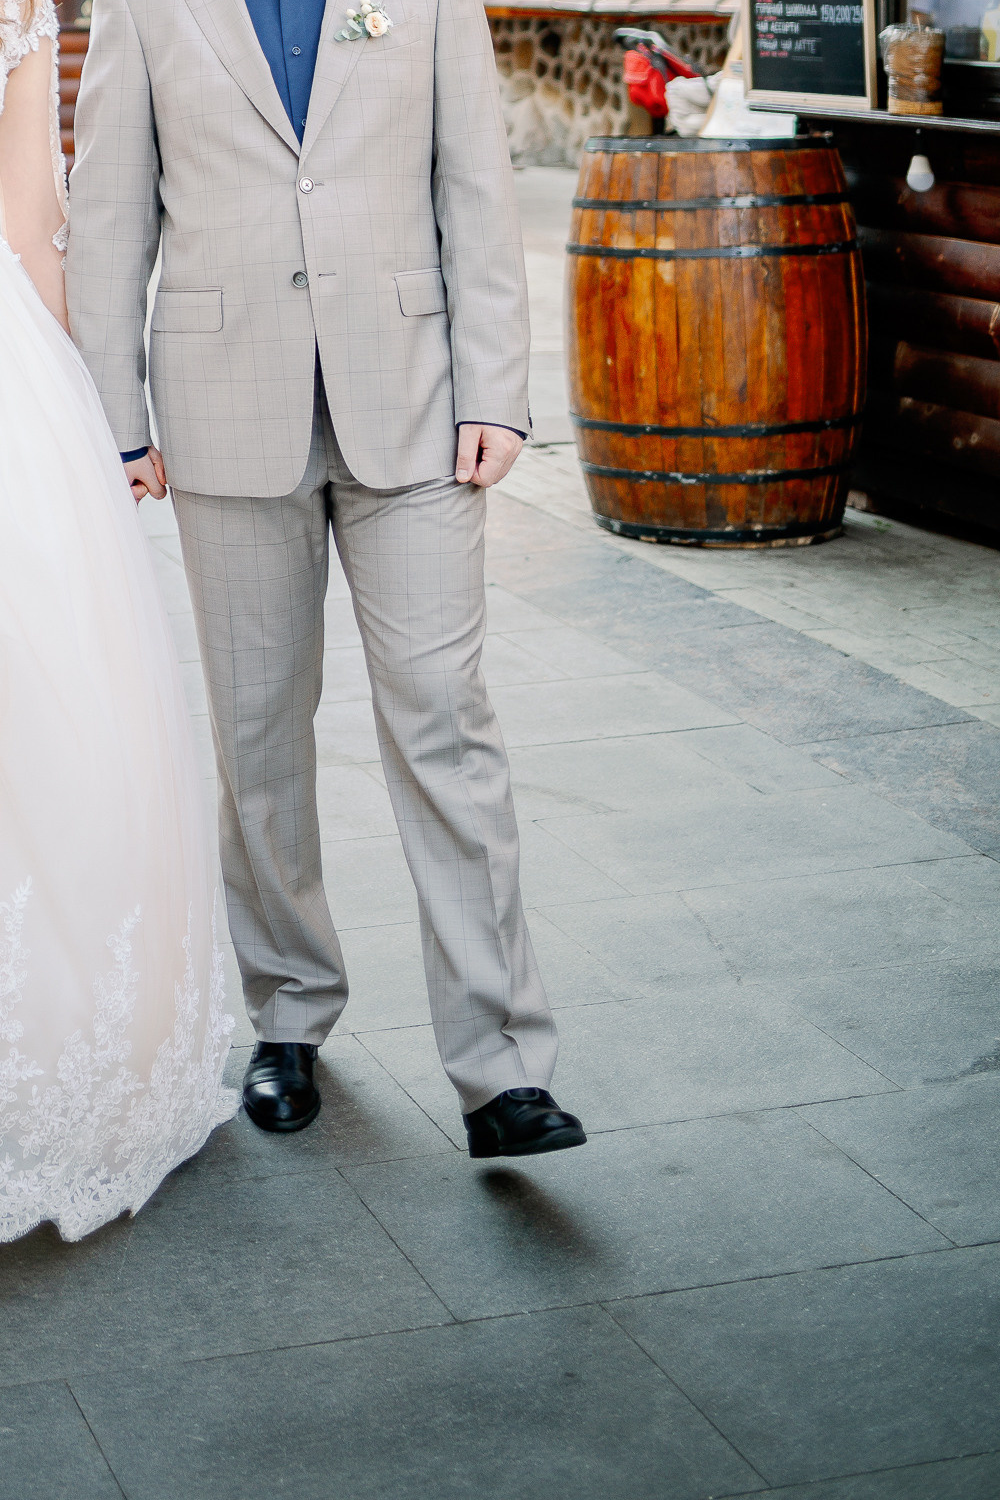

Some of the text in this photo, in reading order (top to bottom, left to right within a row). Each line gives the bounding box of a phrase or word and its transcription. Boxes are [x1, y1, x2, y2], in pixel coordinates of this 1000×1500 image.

[786, 4, 817, 16] ШОКОЛАД
[770, 22, 800, 34] АССОРТИ
[794, 39, 816, 54] ЛАТТЕ
